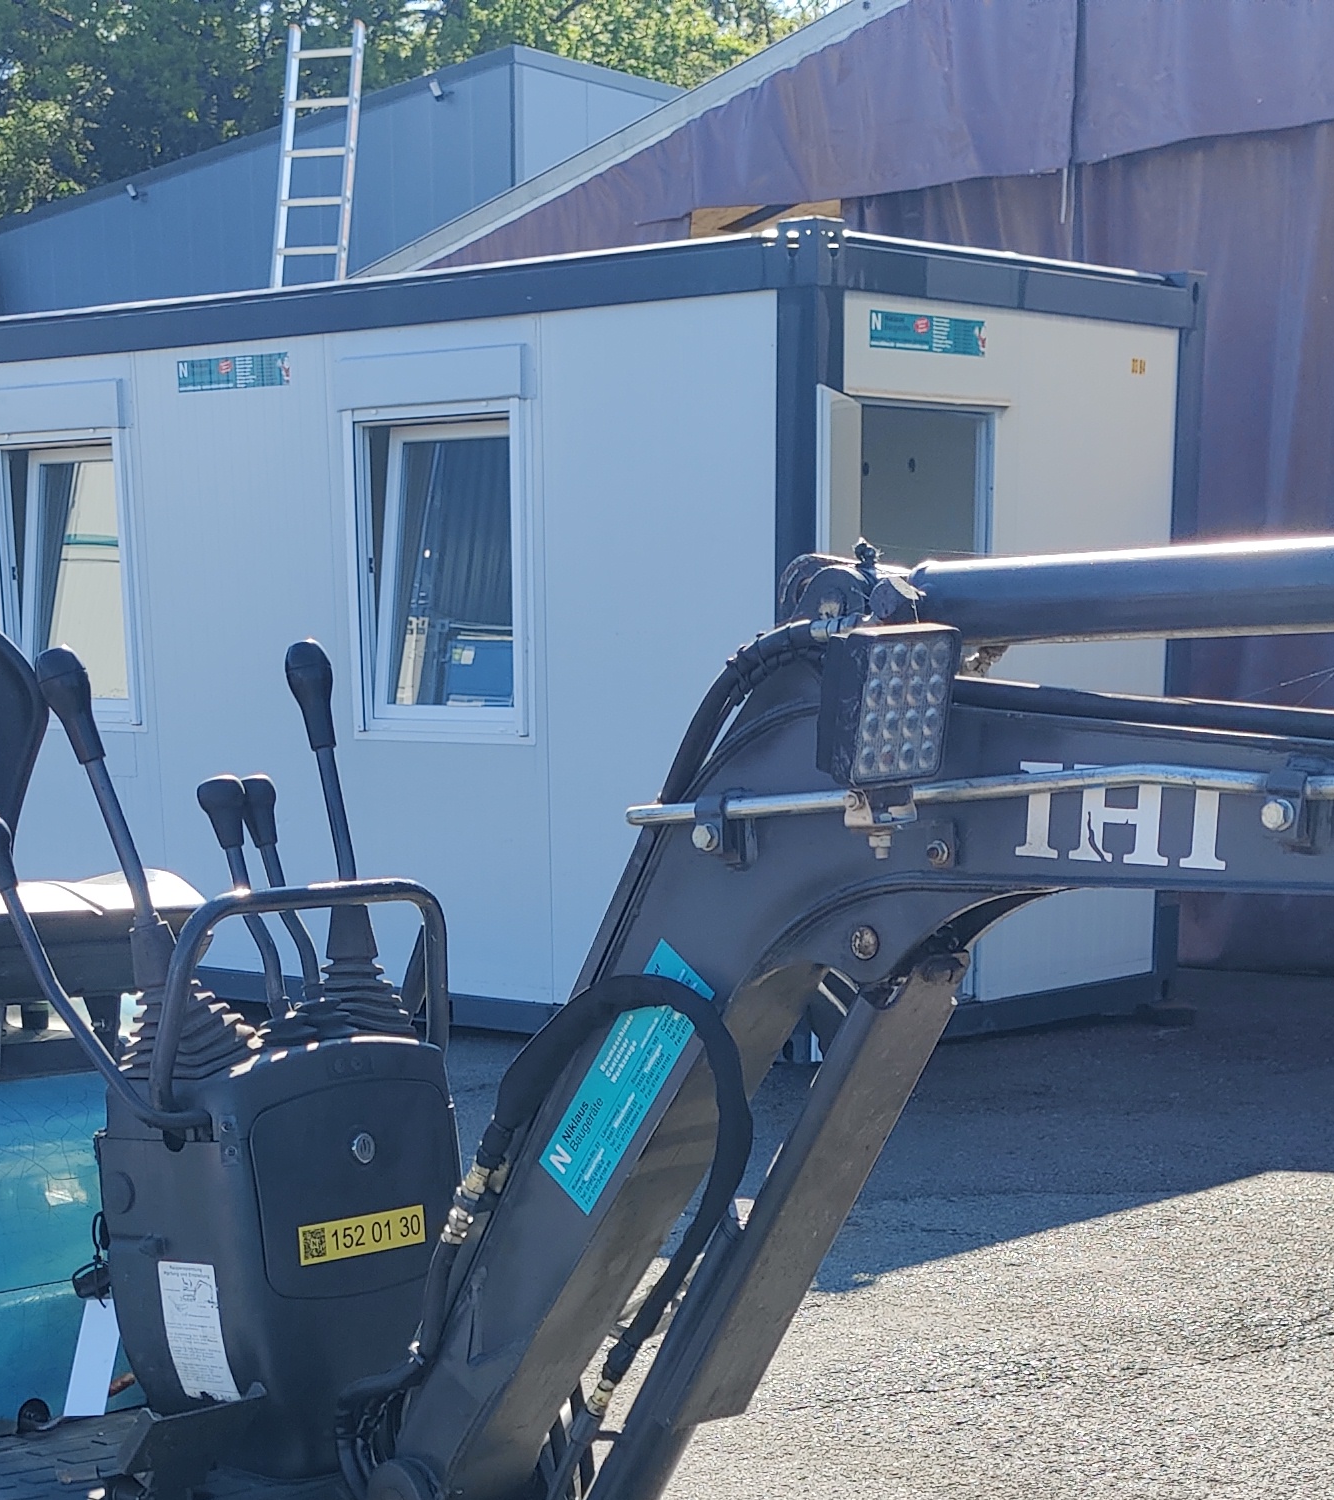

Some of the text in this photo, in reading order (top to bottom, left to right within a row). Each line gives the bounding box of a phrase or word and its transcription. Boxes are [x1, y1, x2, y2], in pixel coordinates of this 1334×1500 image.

[871, 312, 881, 330] N
[178, 362, 187, 378] N
[1015, 760, 1227, 871] IHI
[599, 1014, 634, 1072] Baumaschinen
[605, 1038, 630, 1078] Container
[611, 1040, 637, 1084] Werkzeuge
[561, 1101, 589, 1142] Niklaus
[569, 1097, 604, 1152] Baugeräte
[549, 1144, 572, 1174] N
[331, 1224, 365, 1250] 152
[371, 1220, 392, 1243] 01
[399, 1214, 421, 1238] 30
